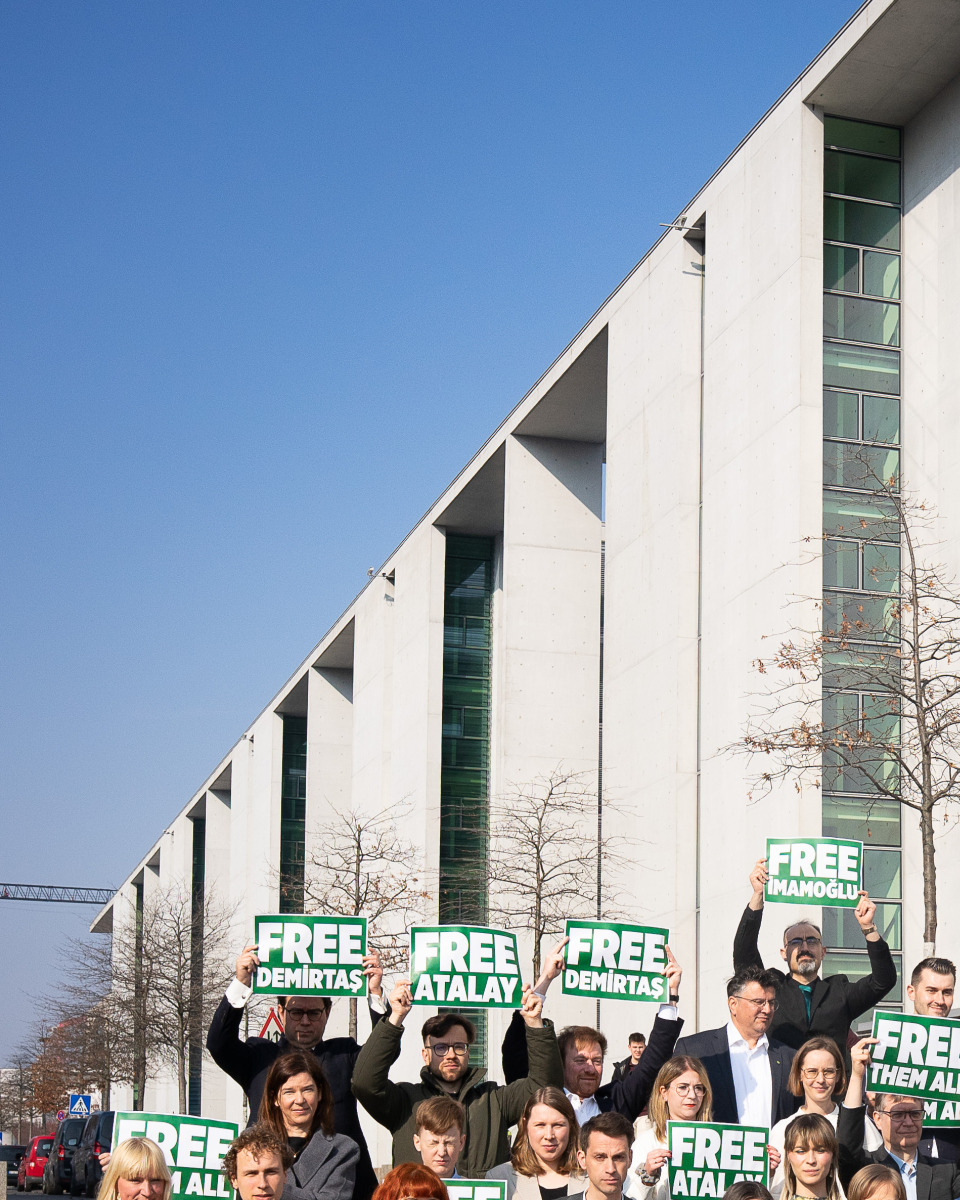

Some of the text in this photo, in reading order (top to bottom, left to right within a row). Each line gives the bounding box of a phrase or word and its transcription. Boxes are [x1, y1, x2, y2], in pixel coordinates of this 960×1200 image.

[769, 843, 859, 881] FREE
[768, 876, 859, 900] İMAMOĞLU
[257, 922, 363, 964] FREE
[414, 932, 519, 975] FREE
[567, 927, 665, 973] FREE
[256, 965, 363, 993] DEMİRTAŞ
[414, 974, 518, 1003] ATALAY
[565, 969, 664, 999] DEMİRTAŞ
[870, 1062, 929, 1090] THEM
[671, 1127, 766, 1172] FREE
